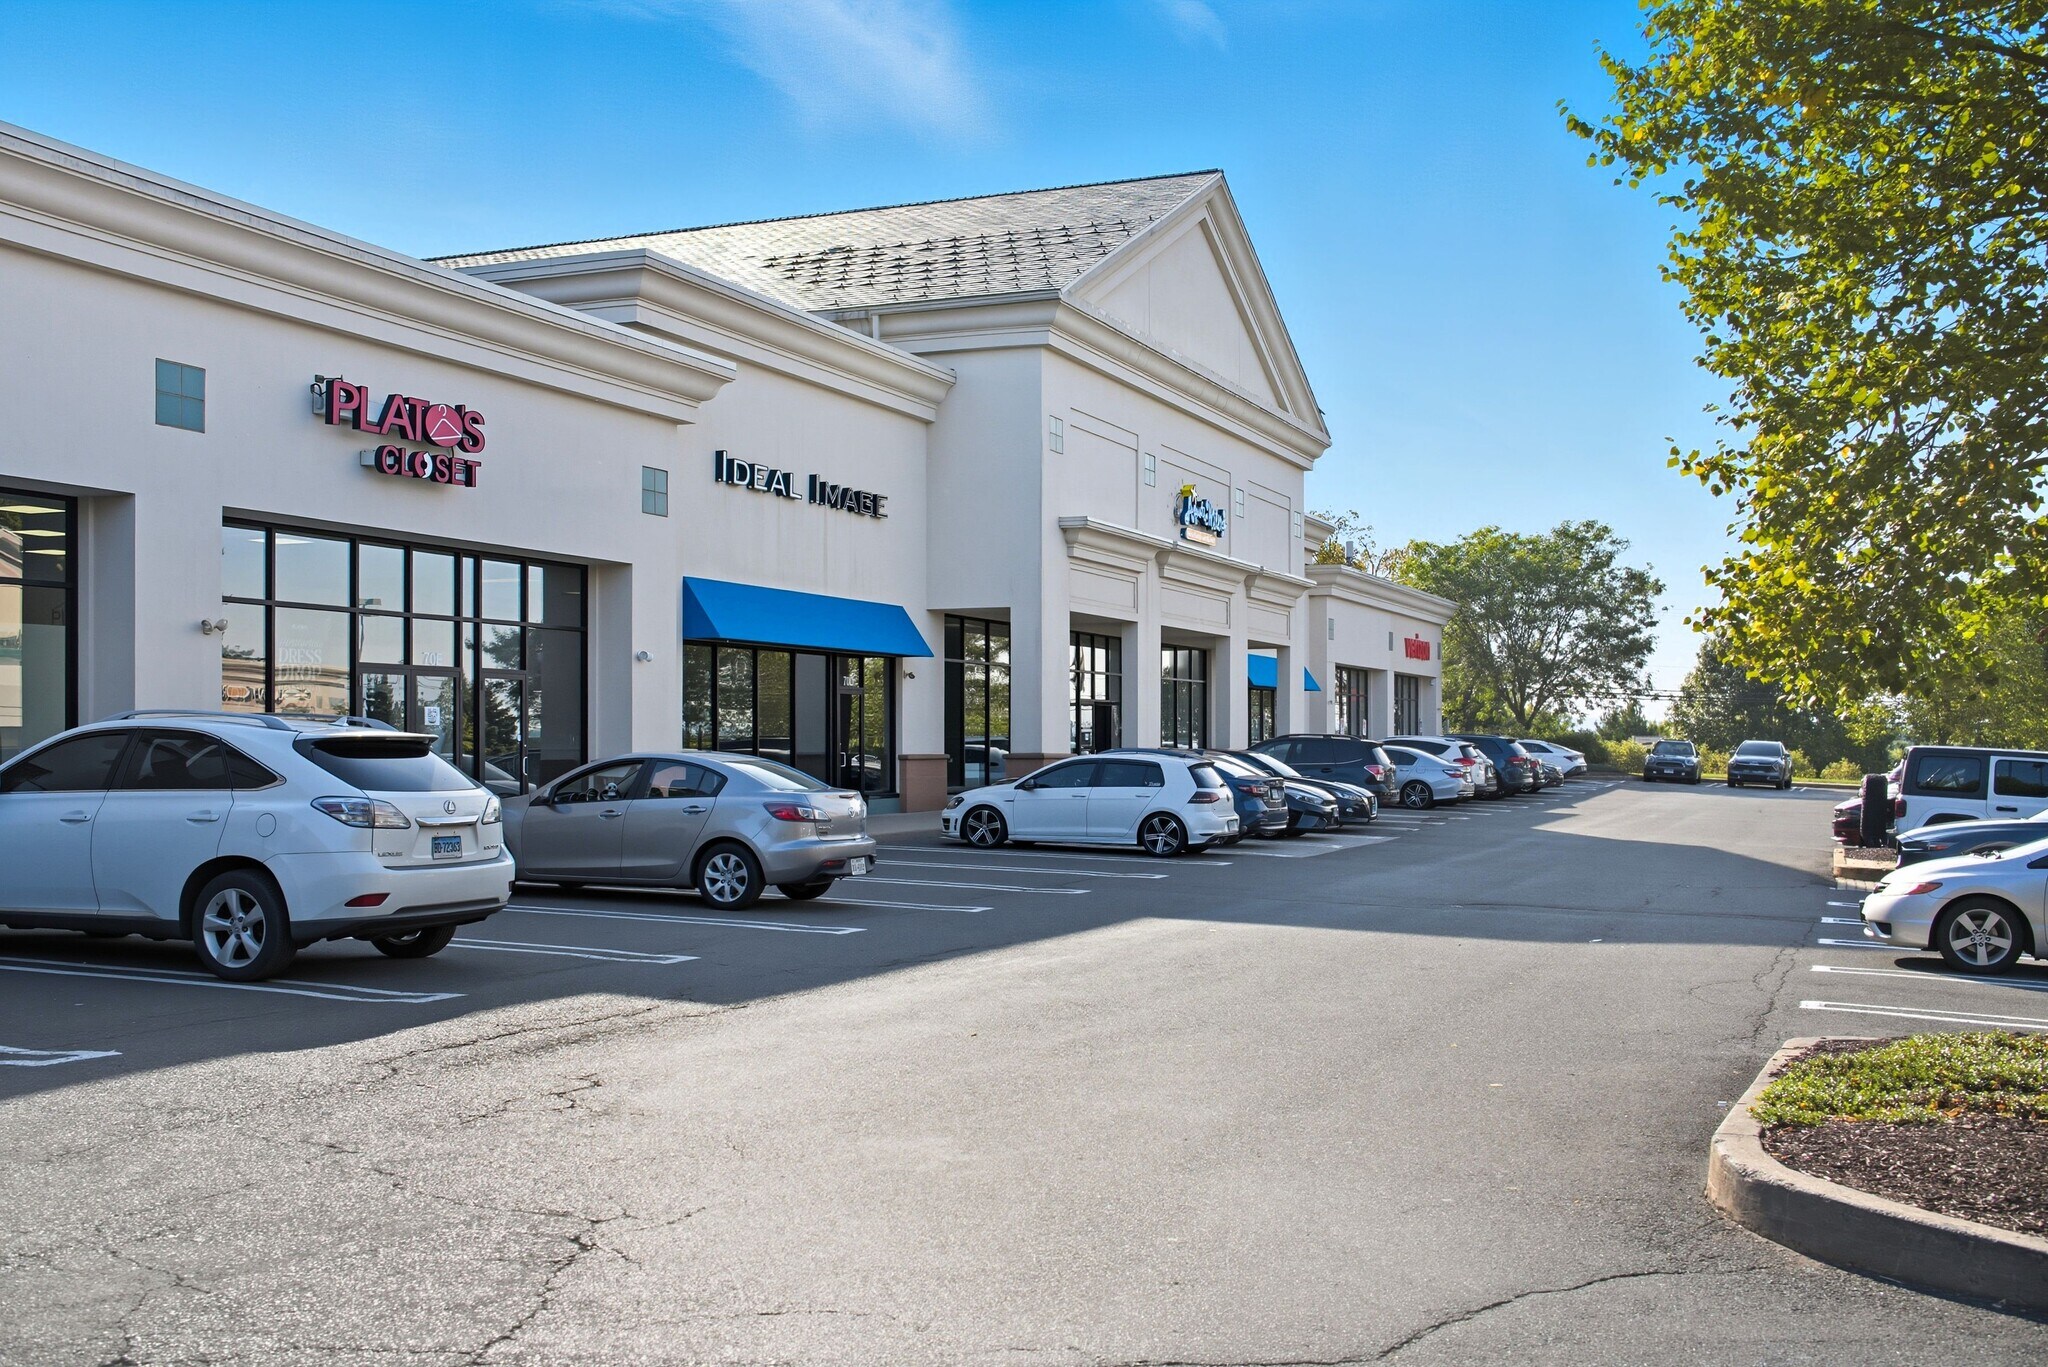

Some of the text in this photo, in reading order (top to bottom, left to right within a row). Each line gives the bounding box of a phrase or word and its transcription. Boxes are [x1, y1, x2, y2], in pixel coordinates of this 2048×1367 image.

[325, 379, 486, 453] PLATO'S
[374, 445, 482, 487] CLOSET
[714, 450, 889, 519] IDEAL IMAGE
[279, 648, 322, 664] DRESS
